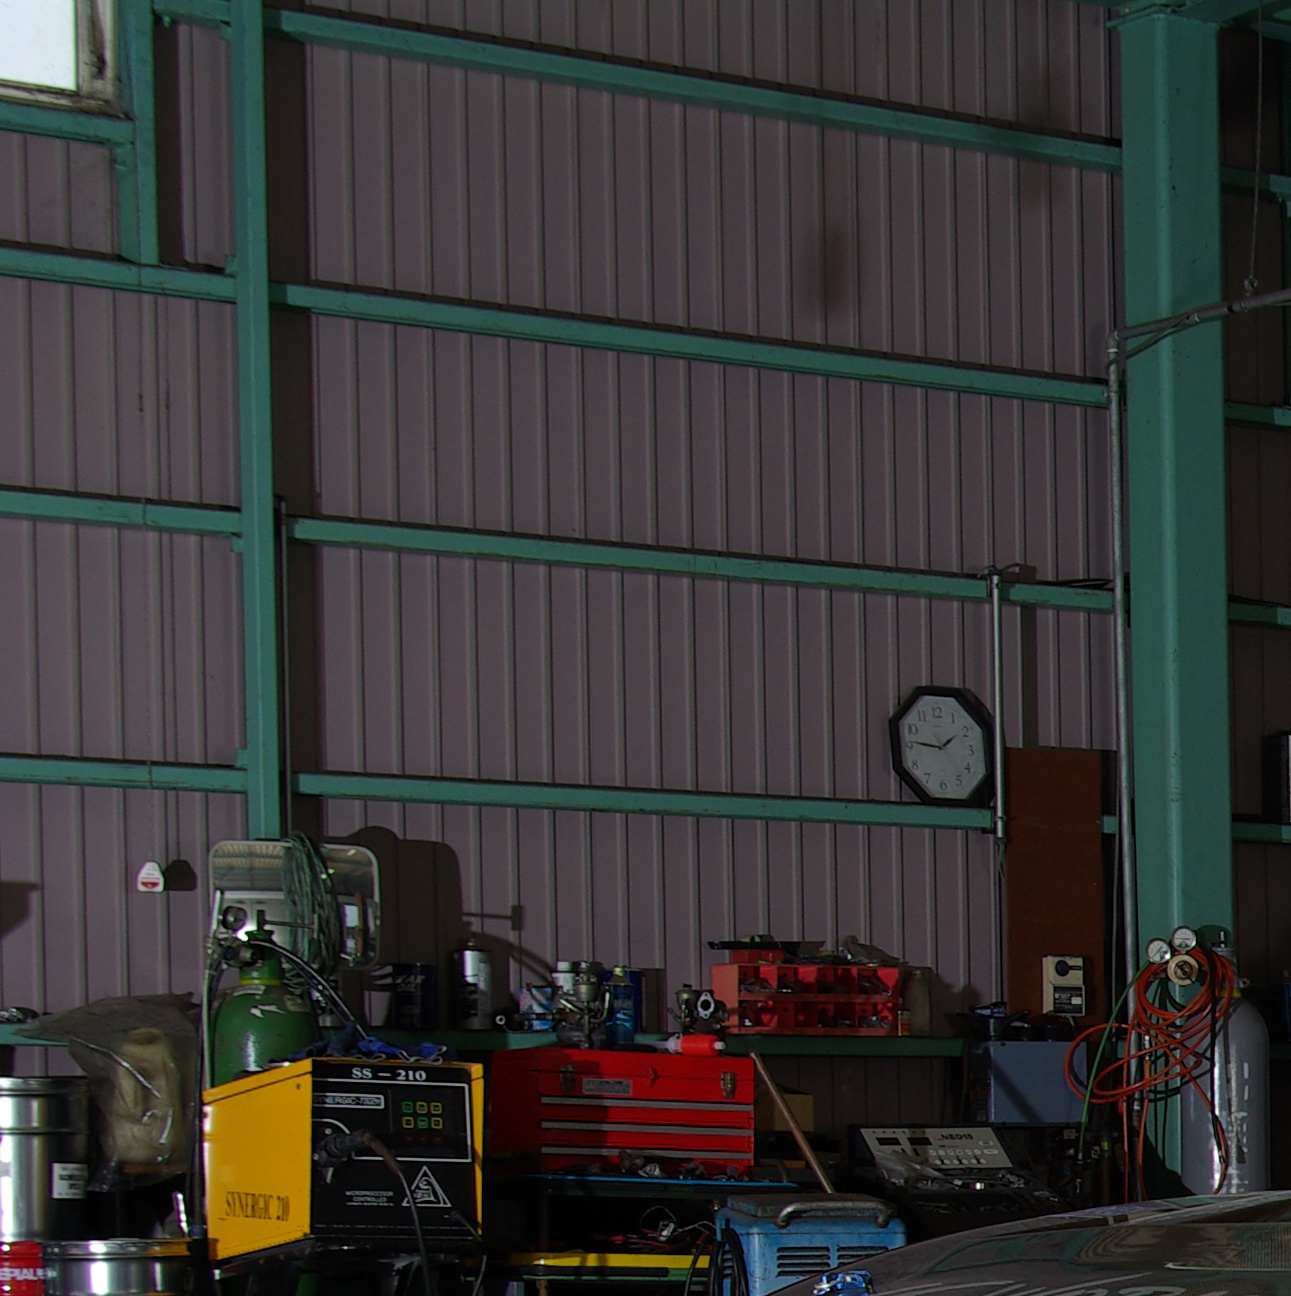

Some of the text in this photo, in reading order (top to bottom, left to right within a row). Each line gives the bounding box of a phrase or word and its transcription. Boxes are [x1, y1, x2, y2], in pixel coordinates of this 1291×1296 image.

[932, 706, 943, 719] 12
[907, 722, 919, 736] 10
[962, 725, 970, 738] 2
[968, 744, 975, 756] 3
[351, 1067, 373, 1080] SS
[396, 1069, 427, 1081] 210
[225, 1191, 272, 1221] SYNERGIC
